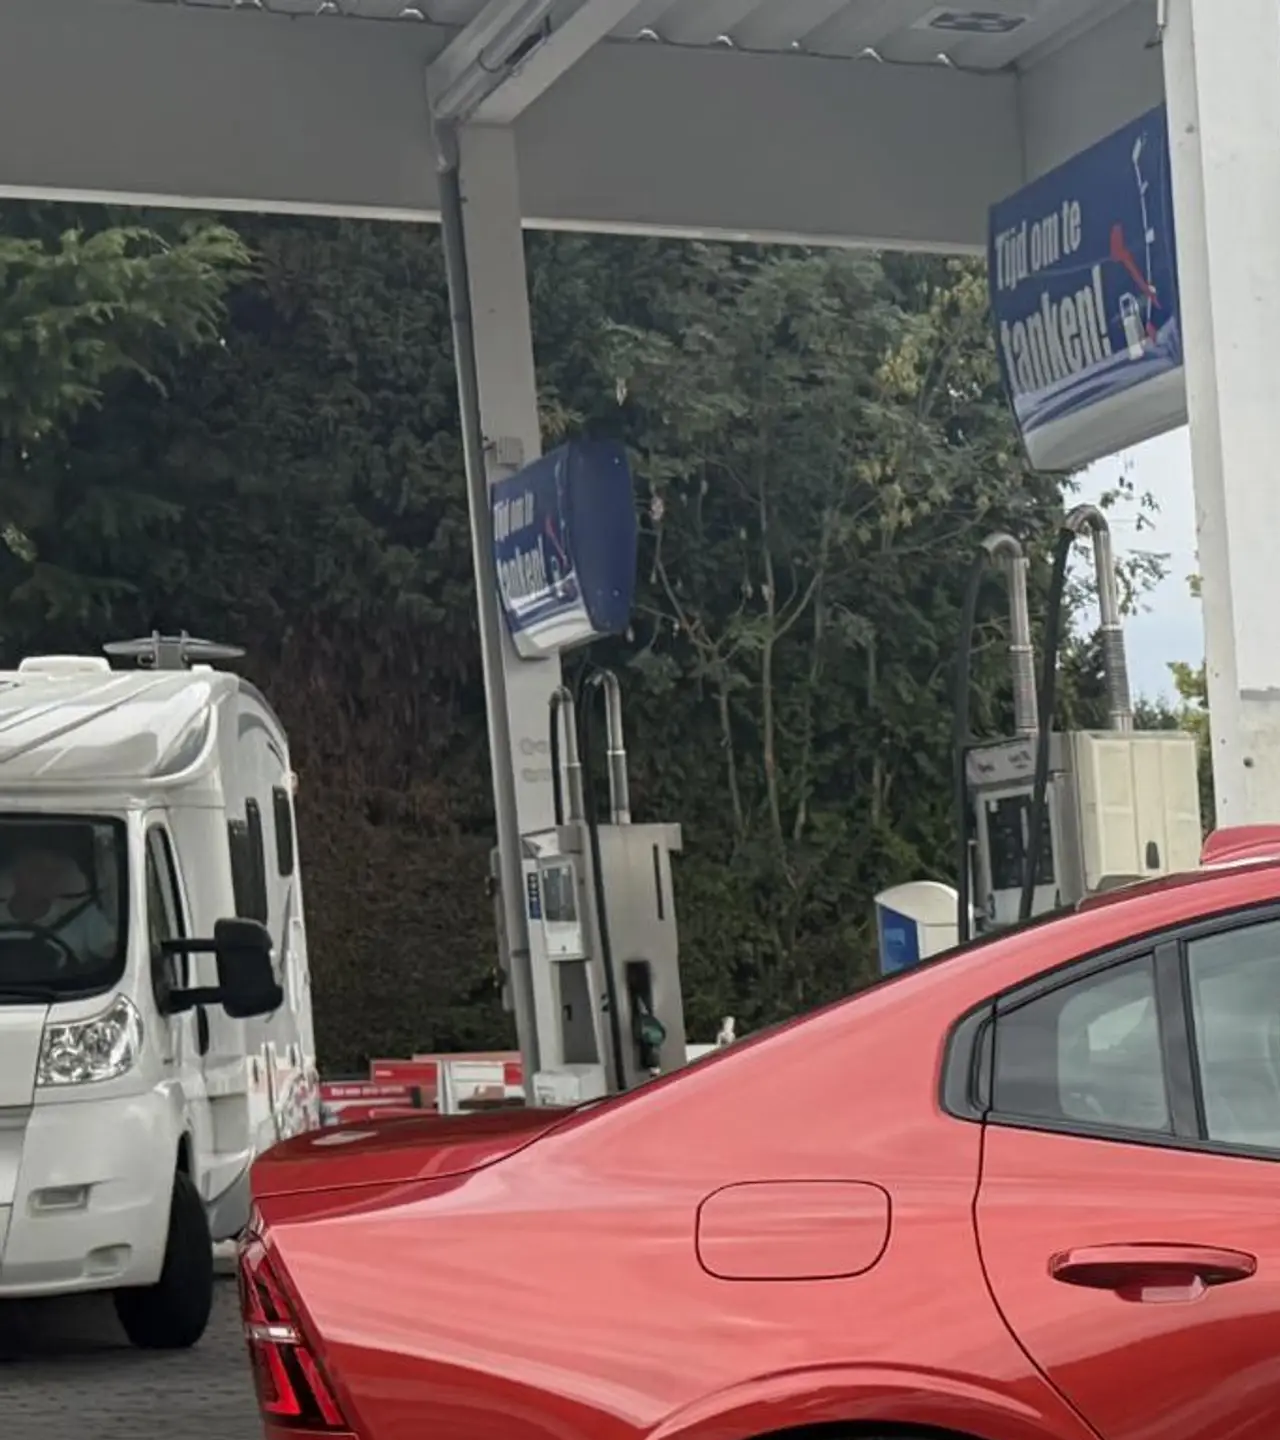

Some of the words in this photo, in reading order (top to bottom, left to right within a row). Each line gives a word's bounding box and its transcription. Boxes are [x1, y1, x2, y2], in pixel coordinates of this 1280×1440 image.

[995, 220, 1028, 291] Tijd
[1031, 211, 1060, 272] om
[1062, 199, 1082, 255] te
[1001, 264, 1113, 396] tanken!
